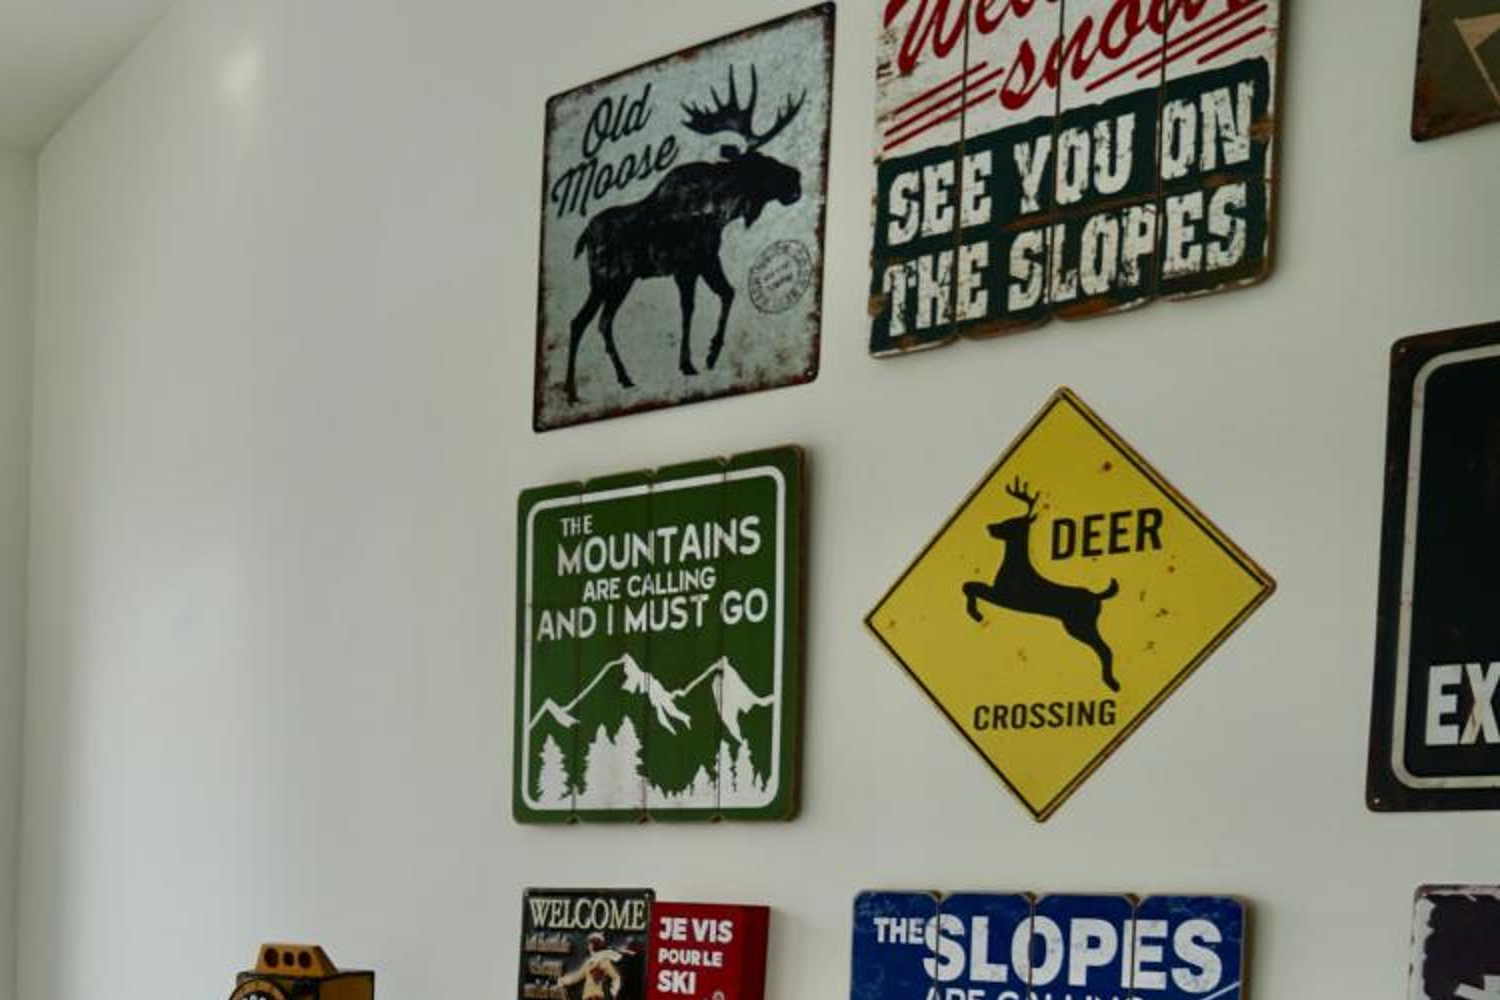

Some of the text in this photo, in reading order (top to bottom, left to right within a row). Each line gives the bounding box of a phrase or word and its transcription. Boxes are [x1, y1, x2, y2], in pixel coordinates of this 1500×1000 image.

[583, 83, 652, 158] Old
[551, 135, 679, 218] Moose
[887, 80, 1255, 246] SEE YOU ON
[882, 240, 990, 337] THE
[1007, 182, 1248, 312] SLOPES
[557, 515, 762, 577] MOUNTAINS
[560, 514, 594, 537] THE
[1050, 507, 1164, 561] DEER
[583, 567, 717, 602] ARE CALLING
[536, 588, 769, 641] AND I MUST GO
[973, 699, 1117, 731] CROSSING
[529, 897, 646, 930] WELCOME
[659, 917, 734, 944] JE VIS
[658, 947, 723, 968] POUR LE
[873, 914, 1224, 993] THE SLOPES
[657, 969, 696, 995] SKI
